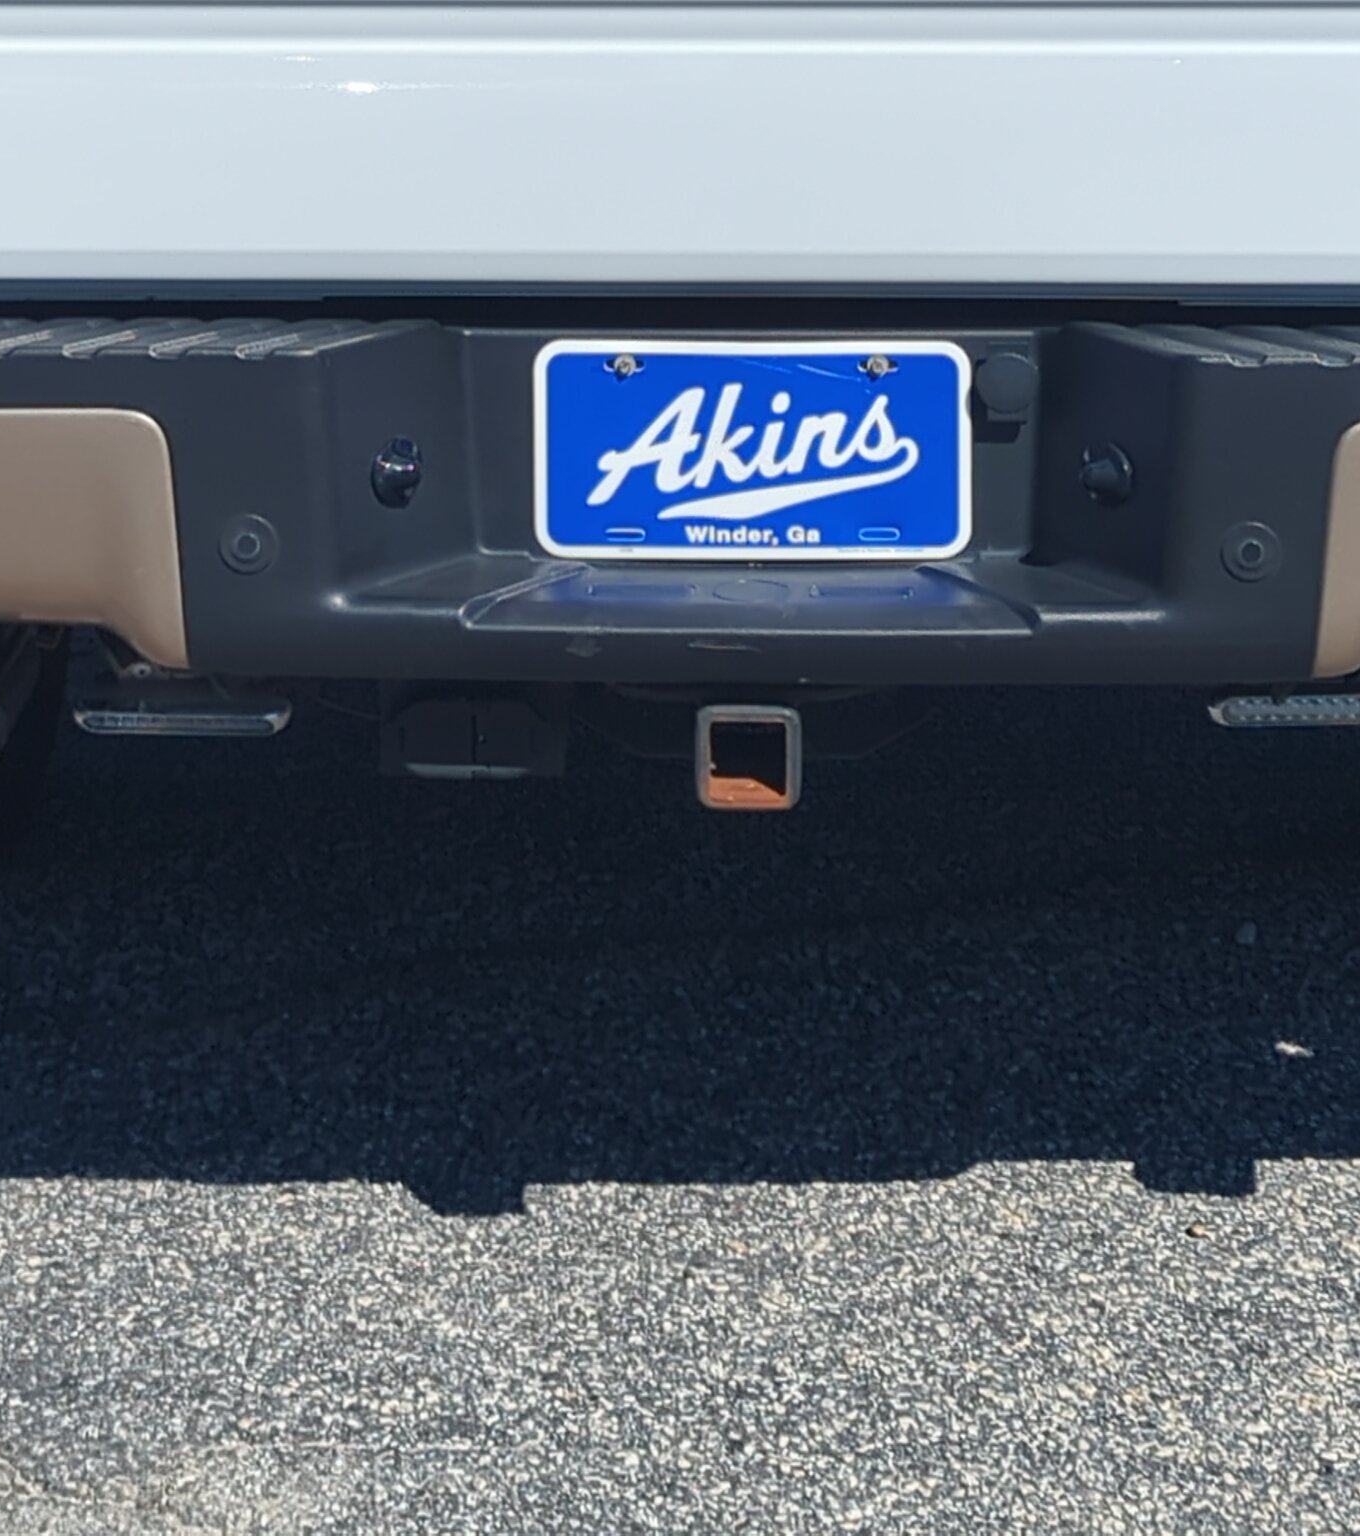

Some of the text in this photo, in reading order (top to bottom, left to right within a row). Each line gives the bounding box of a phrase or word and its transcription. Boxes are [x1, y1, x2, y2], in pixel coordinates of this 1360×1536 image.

[586, 383, 918, 510] Akins
[685, 524, 821, 545] Winder, Ga
